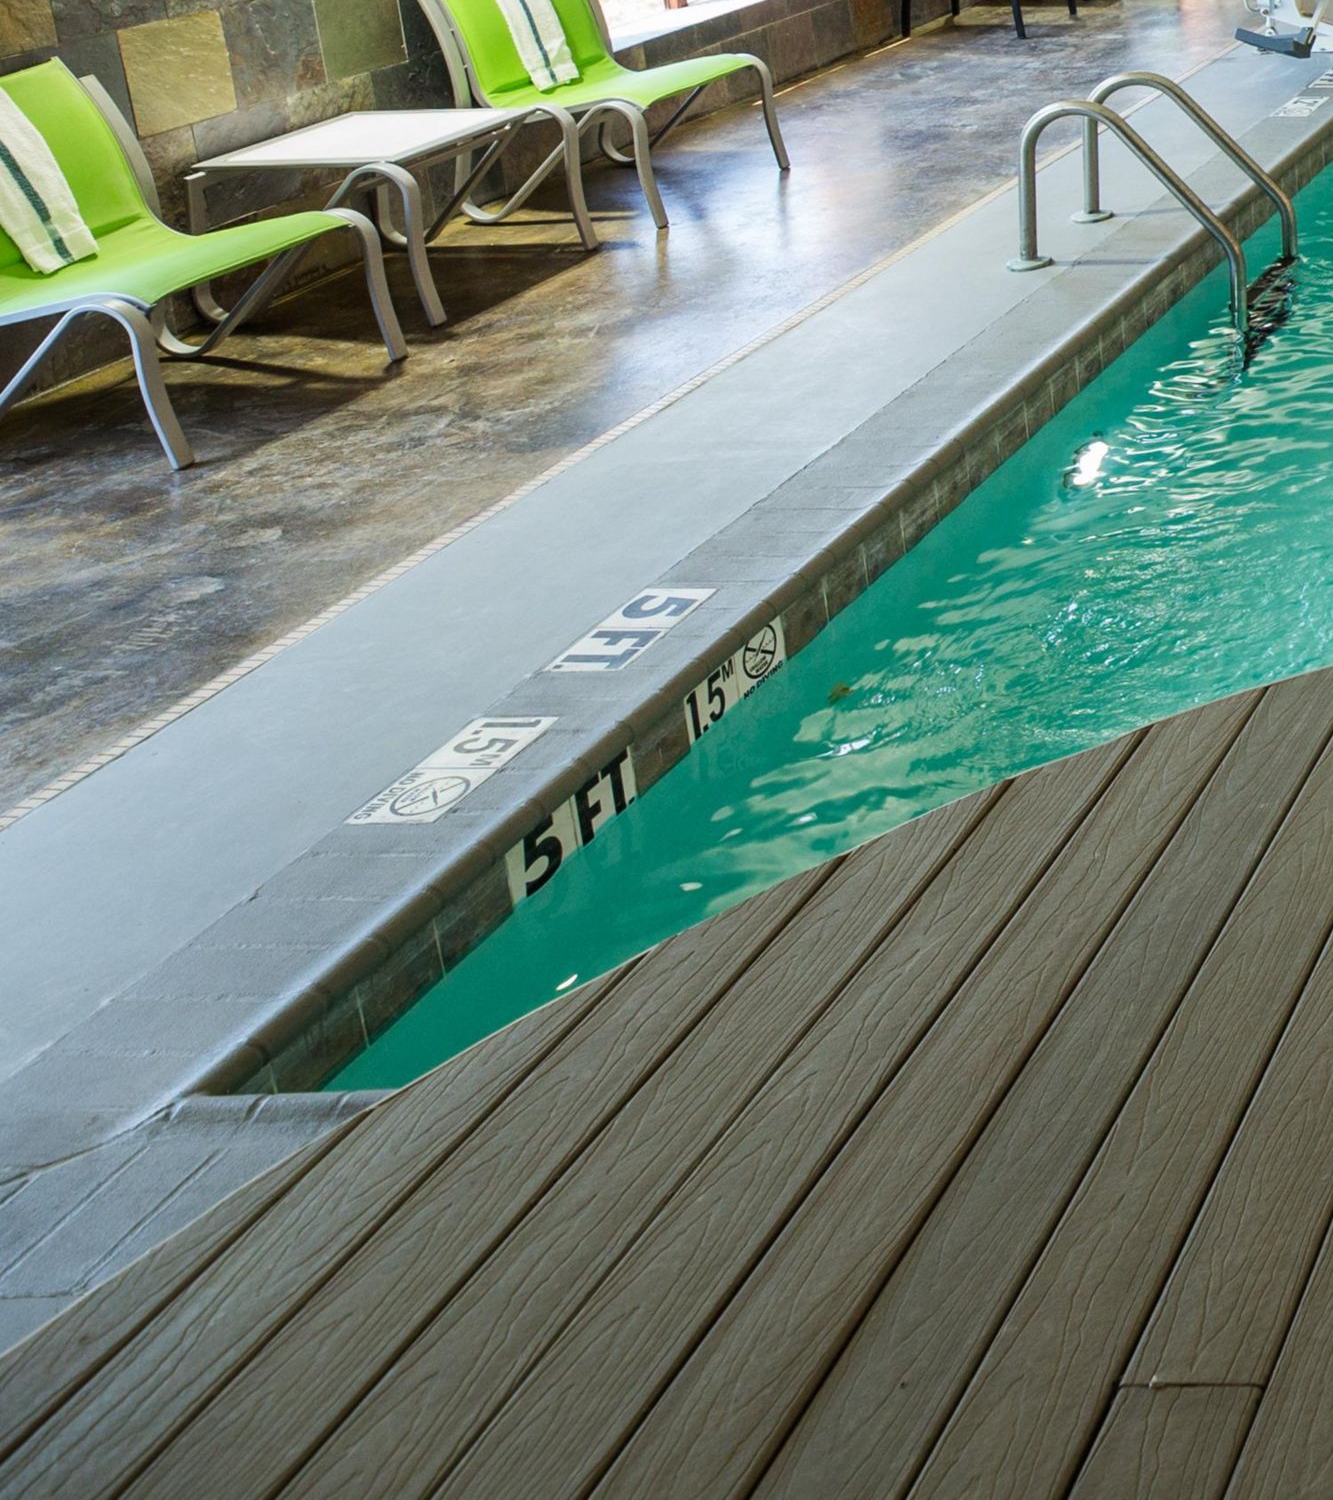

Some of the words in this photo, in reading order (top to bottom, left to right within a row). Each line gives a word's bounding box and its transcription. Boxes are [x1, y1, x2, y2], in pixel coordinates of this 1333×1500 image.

[622, 595, 699, 619] 5
[744, 686, 756, 700] NO
[756, 660, 783, 689] DIVING
[399, 772, 425, 785] NO
[354, 787, 402, 820] DIVING
[523, 813, 563, 898] 5
